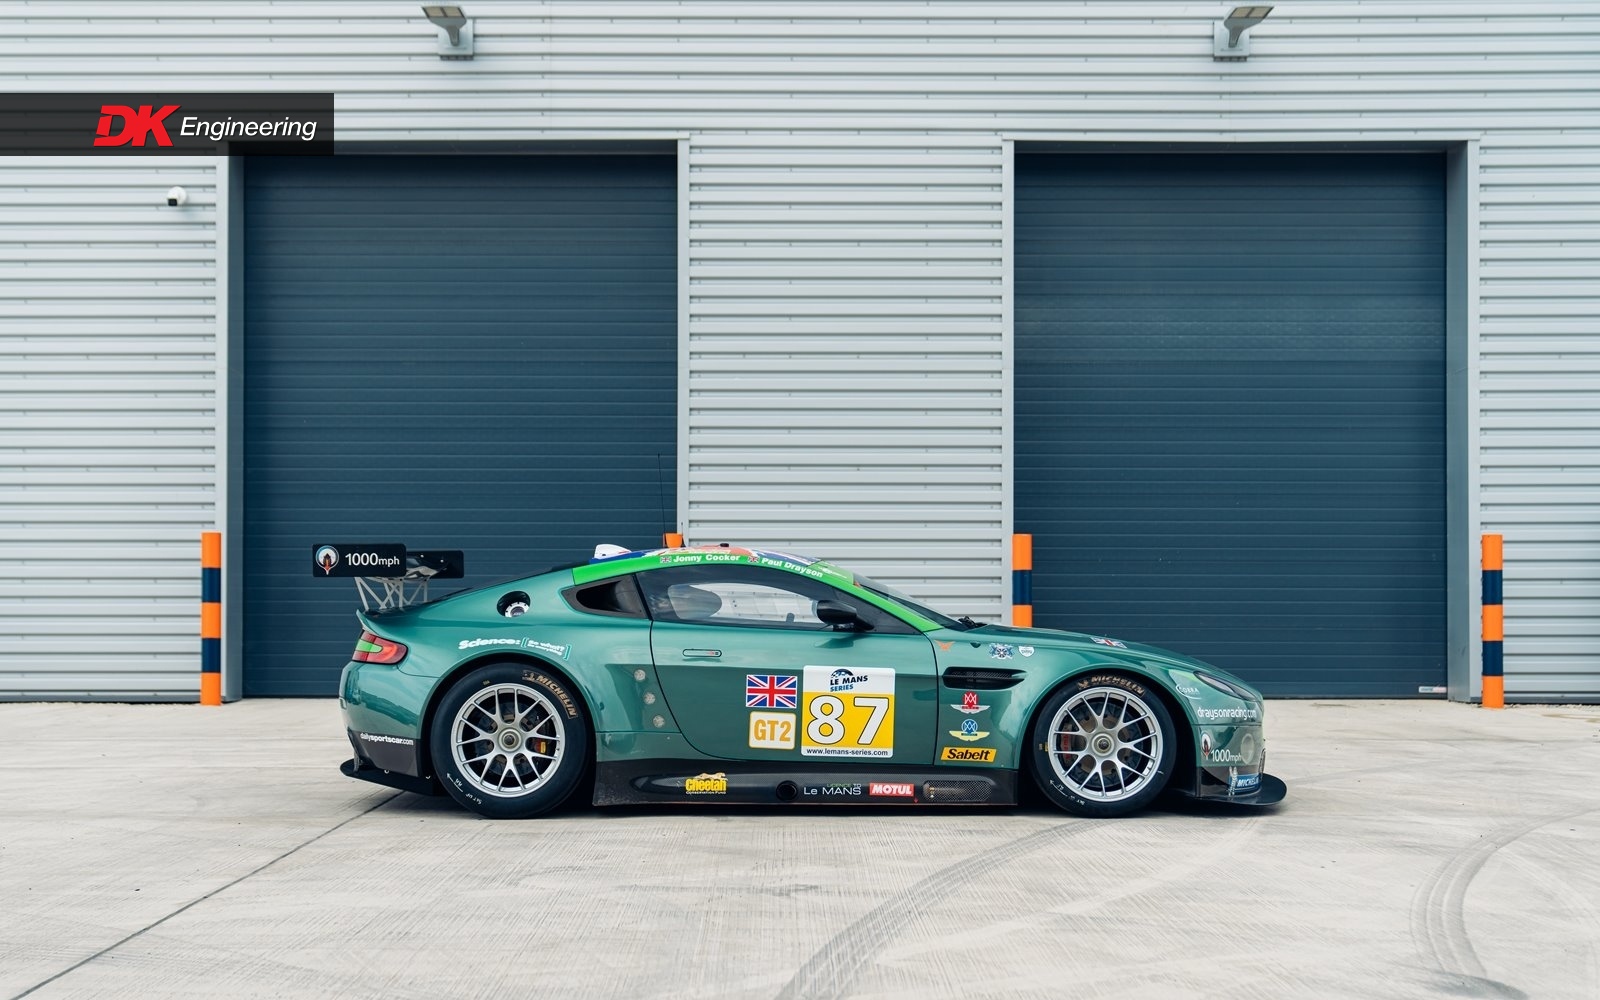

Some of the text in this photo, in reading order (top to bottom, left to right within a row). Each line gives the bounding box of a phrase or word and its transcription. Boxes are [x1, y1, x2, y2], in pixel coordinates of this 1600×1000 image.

[345, 553, 400, 567] 1000mph
[673, 554, 702, 563] Jonny
[761, 557, 783, 567] Paul
[784, 561, 823, 578] Drayson
[458, 638, 520, 650] Science:
[842, 675, 868, 684] MANS
[1091, 676, 1145, 694] MICHELIN
[830, 684, 854, 692] SERIES
[536, 675, 577, 717] MICHELIN
[807, 695, 890, 745] 87
[1197, 706, 1257, 721] draysonracing.com
[753, 719, 792, 742] GT2
[360, 732, 414, 746] dailysportscar.com
[806, 748, 889, 756] www.lemans-series.com
[947, 748, 991, 760] Sabelt
[1211, 749, 1242, 764] 1000mph
[685, 778, 727, 792] Cheetah
[803, 786, 862, 796] Le MANS
[871, 784, 912, 795] MOTUL
